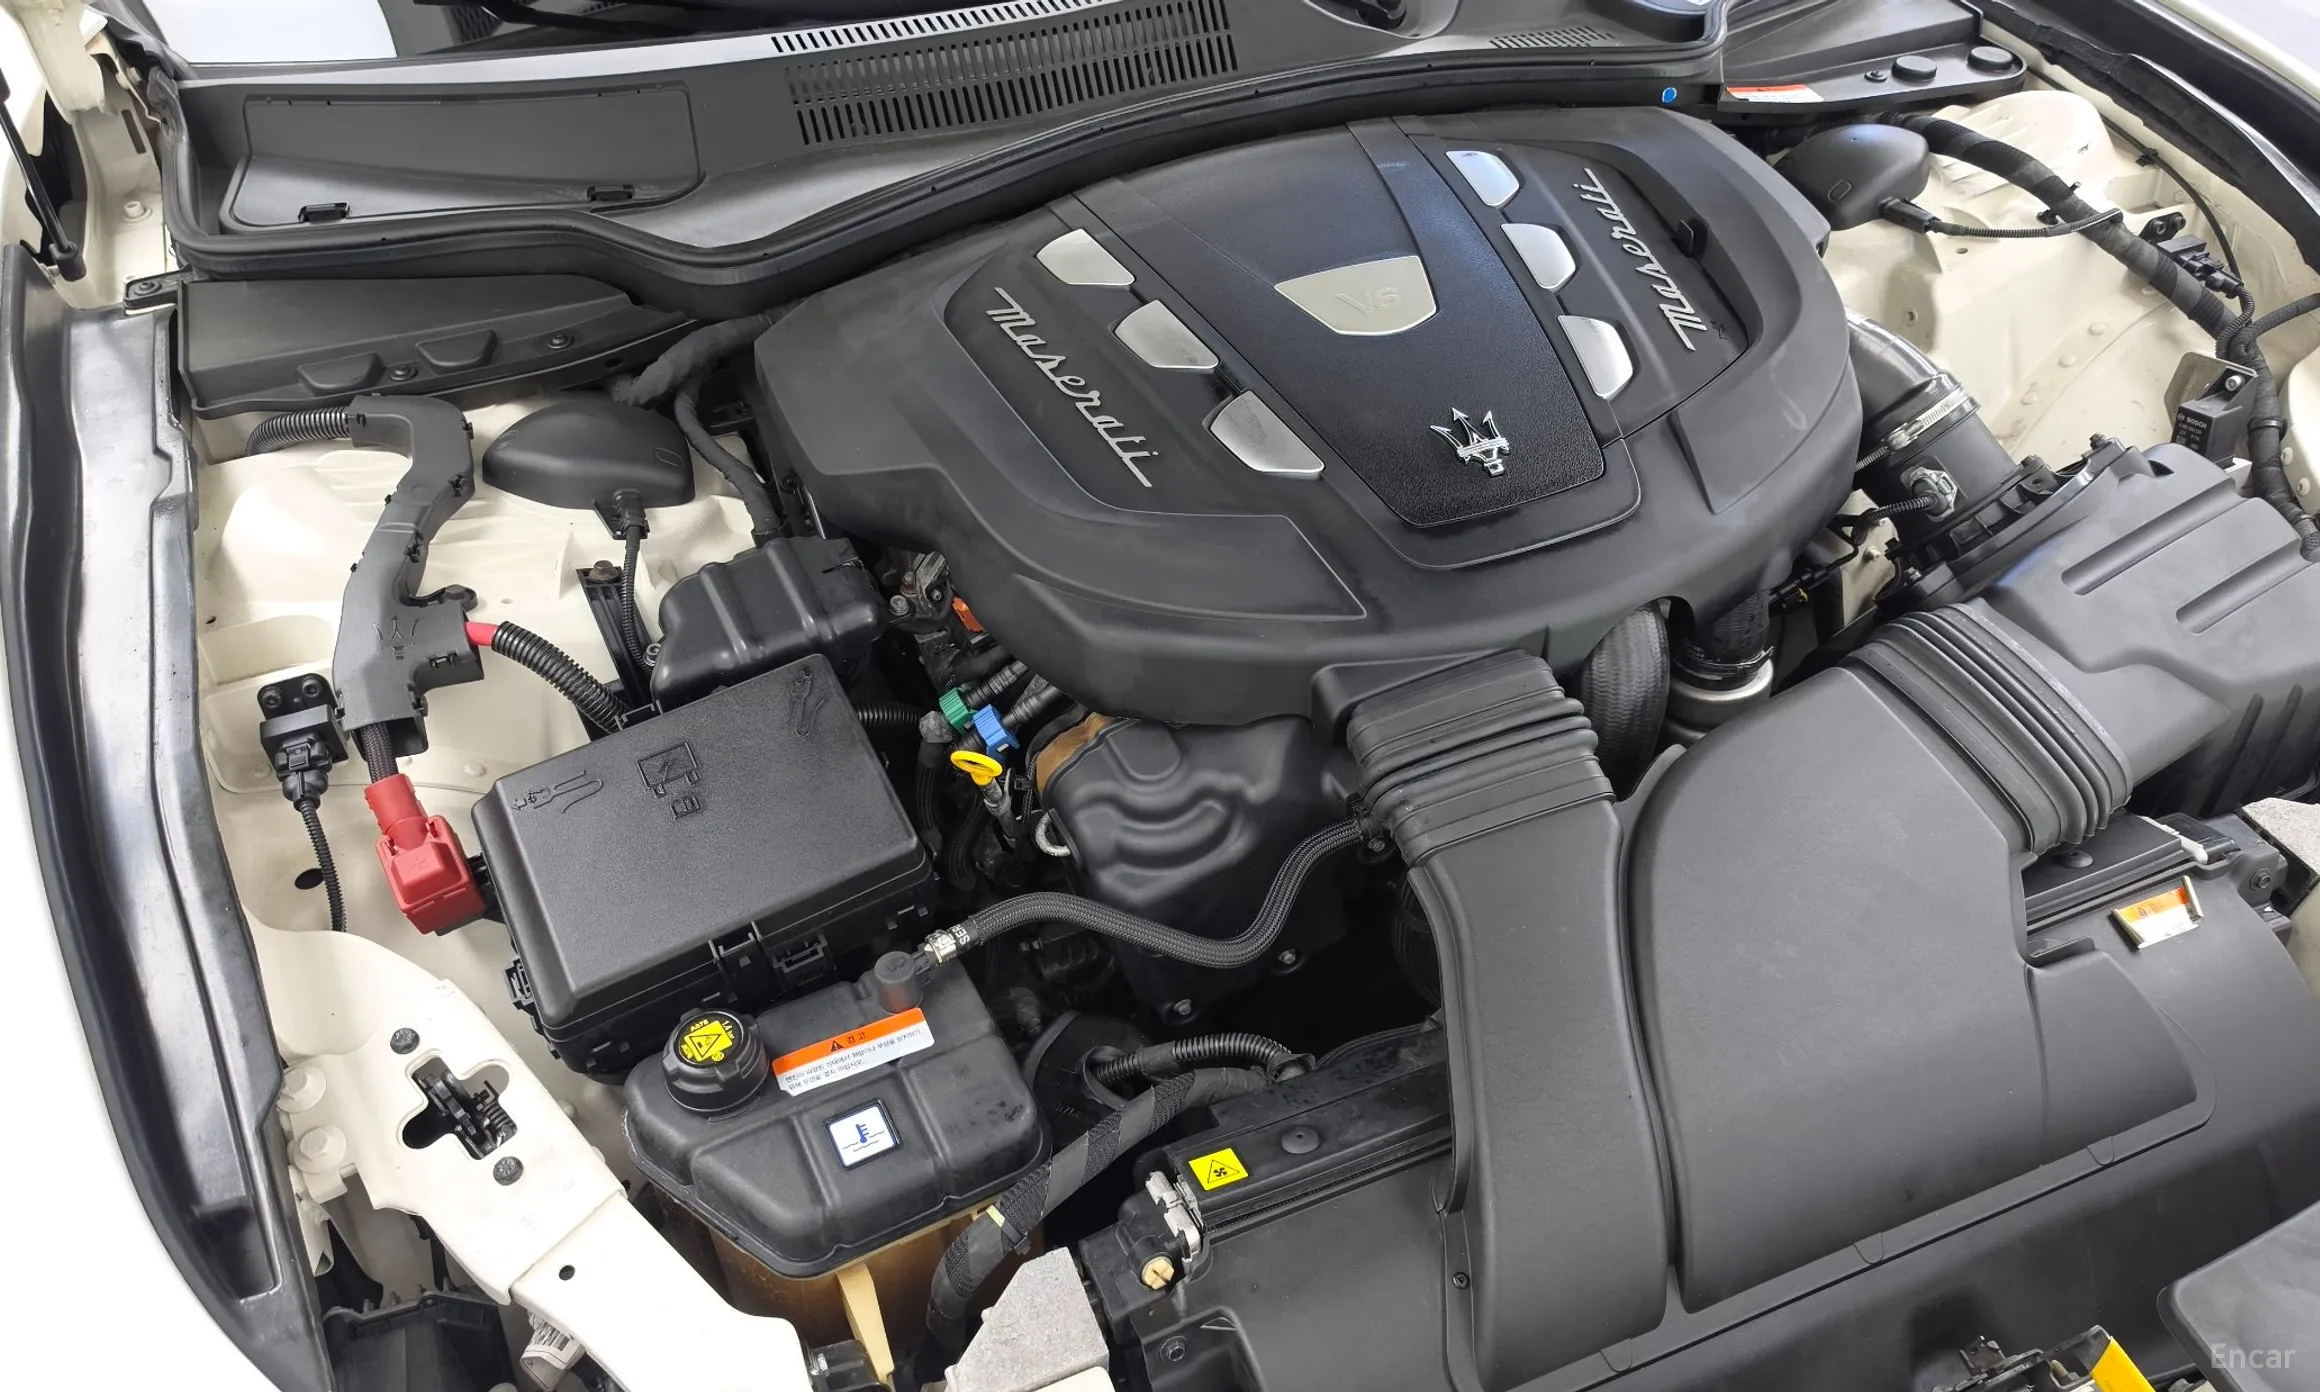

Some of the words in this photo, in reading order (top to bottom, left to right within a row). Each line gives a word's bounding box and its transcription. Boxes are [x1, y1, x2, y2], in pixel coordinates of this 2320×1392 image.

[1335, 286, 1398, 316] V6
[1573, 167, 1708, 351] Maserati
[986, 286, 1159, 488] Maserati
[2186, 416, 2207, 430] BOSCH
